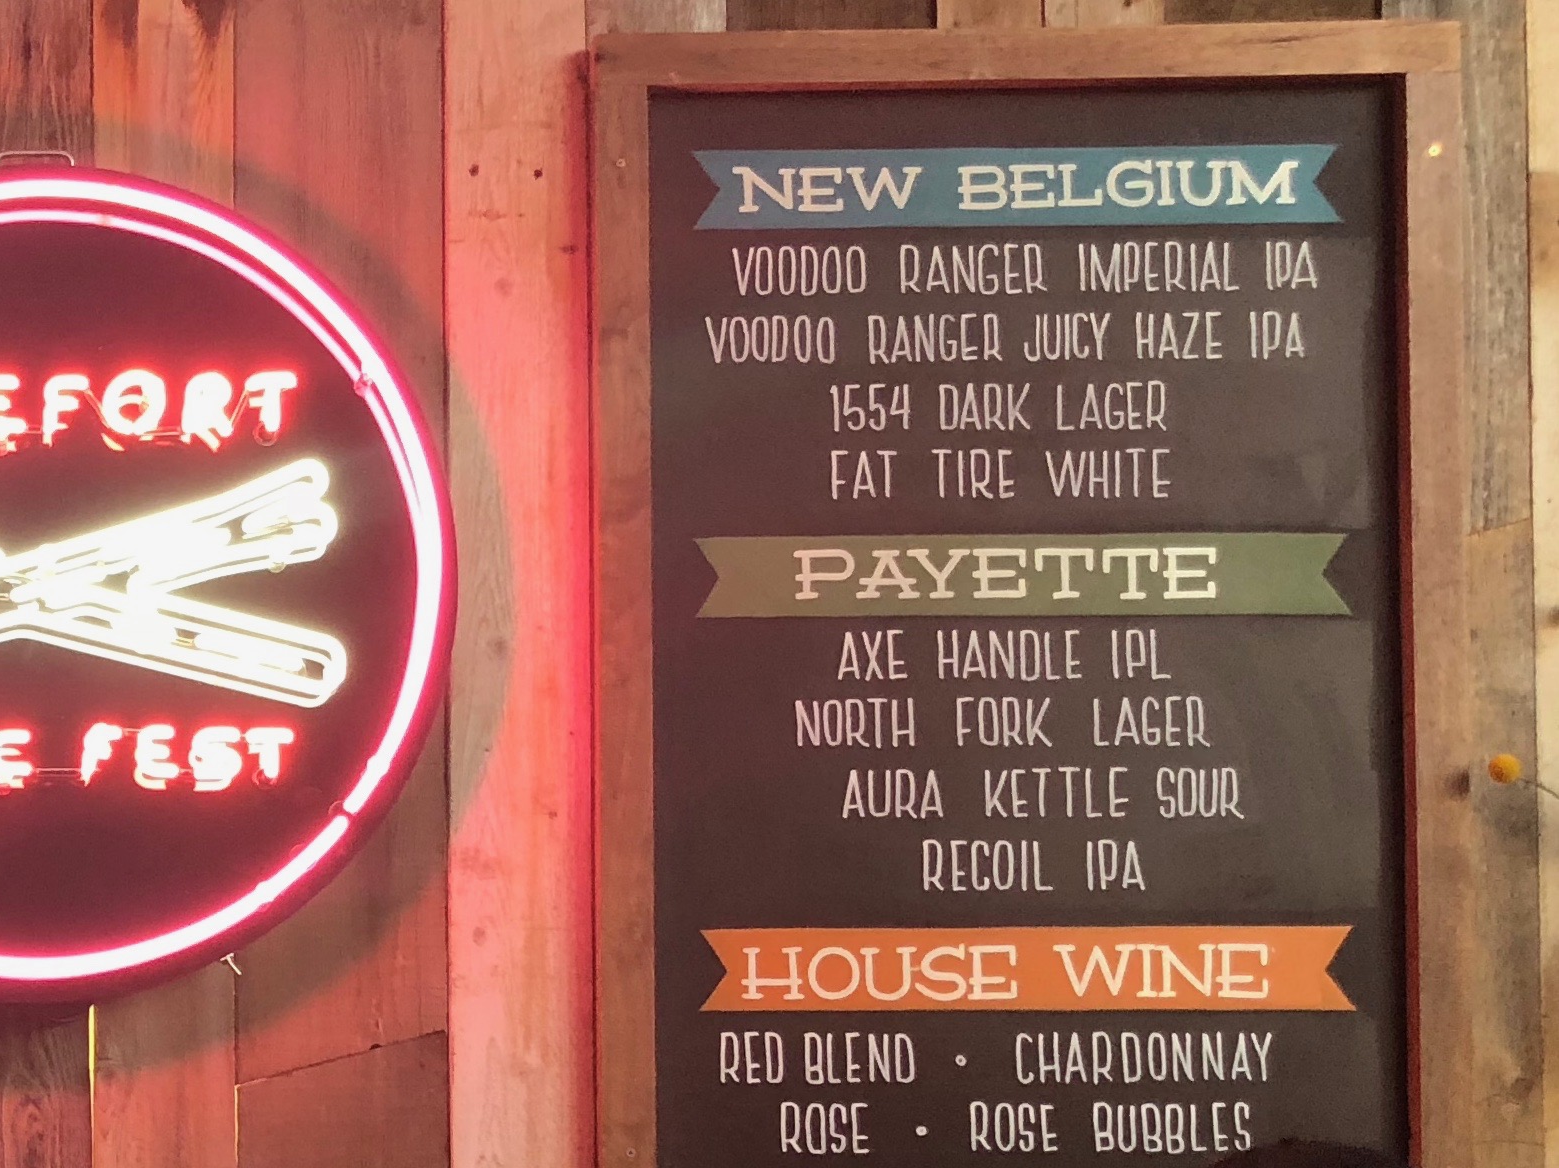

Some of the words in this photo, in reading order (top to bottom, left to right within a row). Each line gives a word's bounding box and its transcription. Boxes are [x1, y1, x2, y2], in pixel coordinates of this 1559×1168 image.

[732, 167, 922, 212] NEW
[958, 160, 1299, 209] BELGIUM
[732, 246, 866, 295] VOODOO
[900, 243, 1047, 294] RANGER
[1079, 241, 1239, 292] IMPERIAL
[1266, 241, 1317, 289] IPA
[705, 315, 834, 363] VOODOO
[868, 313, 1002, 364] RANGER
[1024, 313, 1110, 361] JUICY
[1136, 312, 1222, 359] HAZE
[1250, 311, 1304, 359] IPA
[830, 384, 910, 431] 1554
[939, 383, 1030, 430] DARK
[1057, 380, 1166, 430] LAGER
[831, 450, 896, 499] FAT
[932, 449, 1014, 498] TIRE
[1046, 448, 1170, 498] WHITE
[794, 547, 1217, 599] PAYETTE
[838, 630, 907, 681] AXE
[938, 630, 1081, 681] HANDLE
[1112, 629, 1171, 679] IPL
[795, 698, 915, 748] NORTH
[957, 697, 1052, 747] FORK
[1094, 696, 1210, 746] LAGER
[81, 722, 295, 789] FEST
[843, 769, 943, 818] AURA
[985, 767, 1128, 817] KETTLE
[1157, 767, 1244, 819] SOUR
[923, 840, 1053, 891] RECOIL
[1087, 840, 1145, 890] IPA
[742, 944, 1017, 1001] HOUSE
[1054, 943, 1269, 999] WINE
[721, 1032, 783, 1083] RED
[804, 1032, 915, 1084] BLEND
[1016, 1031, 1272, 1084] CHARDONNAY
[781, 1102, 869, 1154] ROSE
[970, 1101, 1057, 1151] ROSE
[1093, 1102, 1250, 1153] BUBBLES
